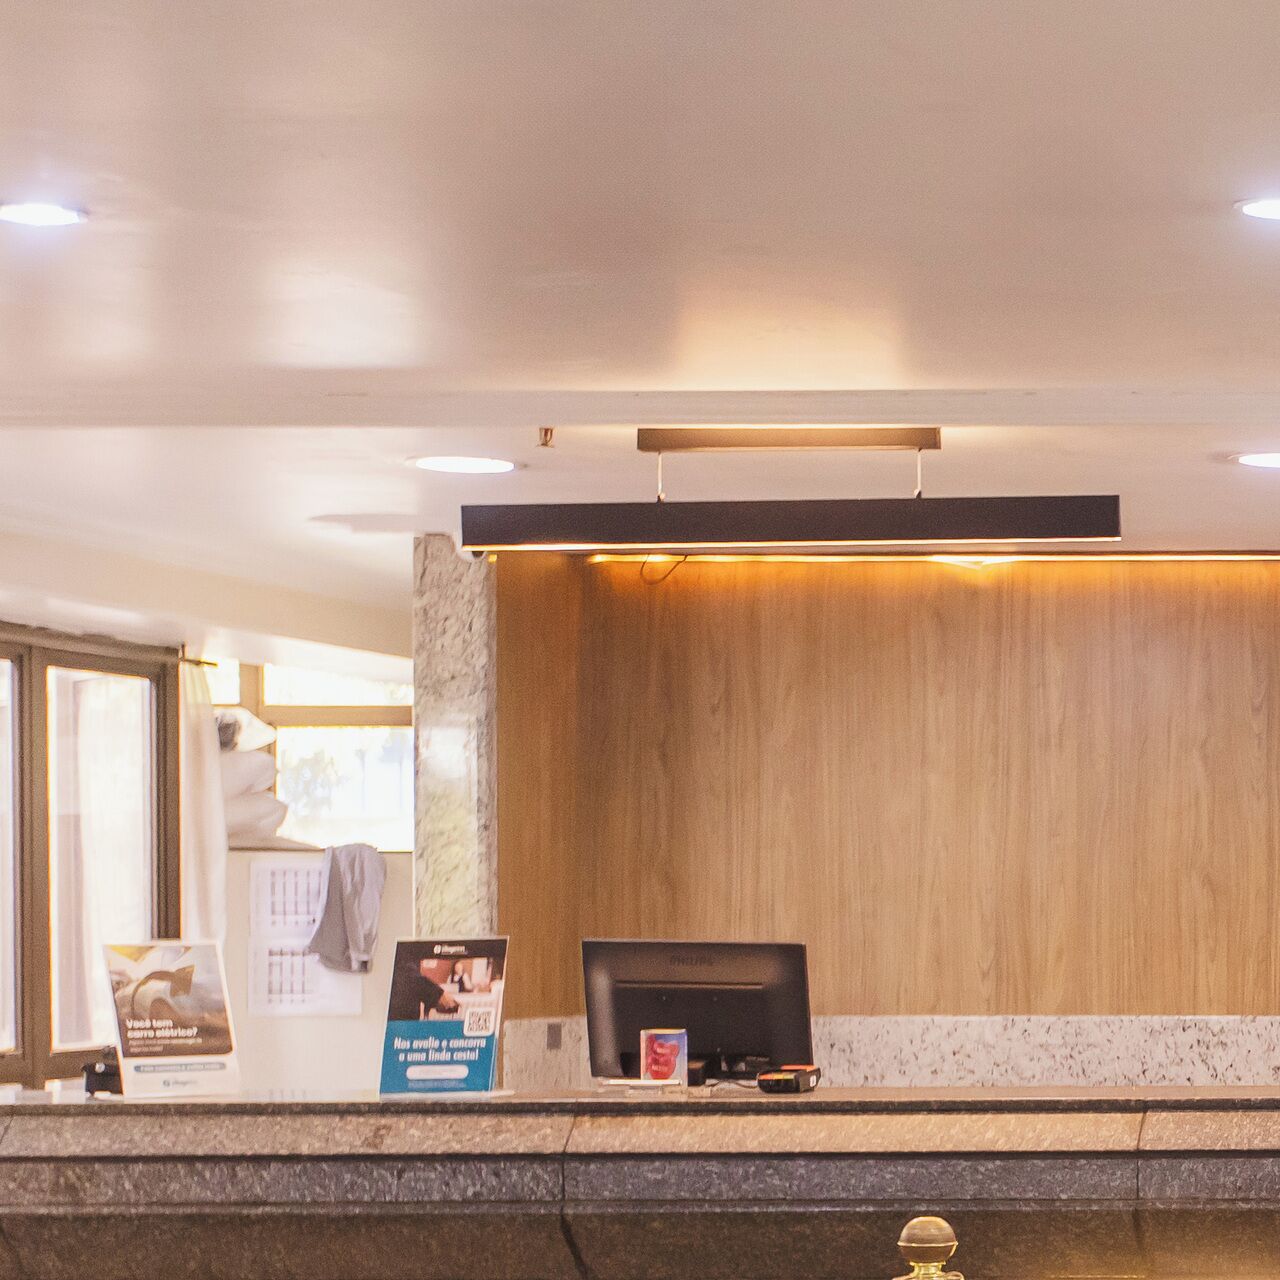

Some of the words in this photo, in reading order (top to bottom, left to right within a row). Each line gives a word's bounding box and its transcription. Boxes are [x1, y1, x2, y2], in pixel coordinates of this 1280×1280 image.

[126, 1018, 151, 1029] Você
[152, 1019, 173, 1028] tem
[127, 1029, 154, 1038] carro
[394, 1037, 410, 1049] Nos
[412, 1036, 439, 1049] avalie
[449, 1039, 486, 1048] concorra
[407, 1052, 426, 1061] uma
[428, 1049, 451, 1061] linda
